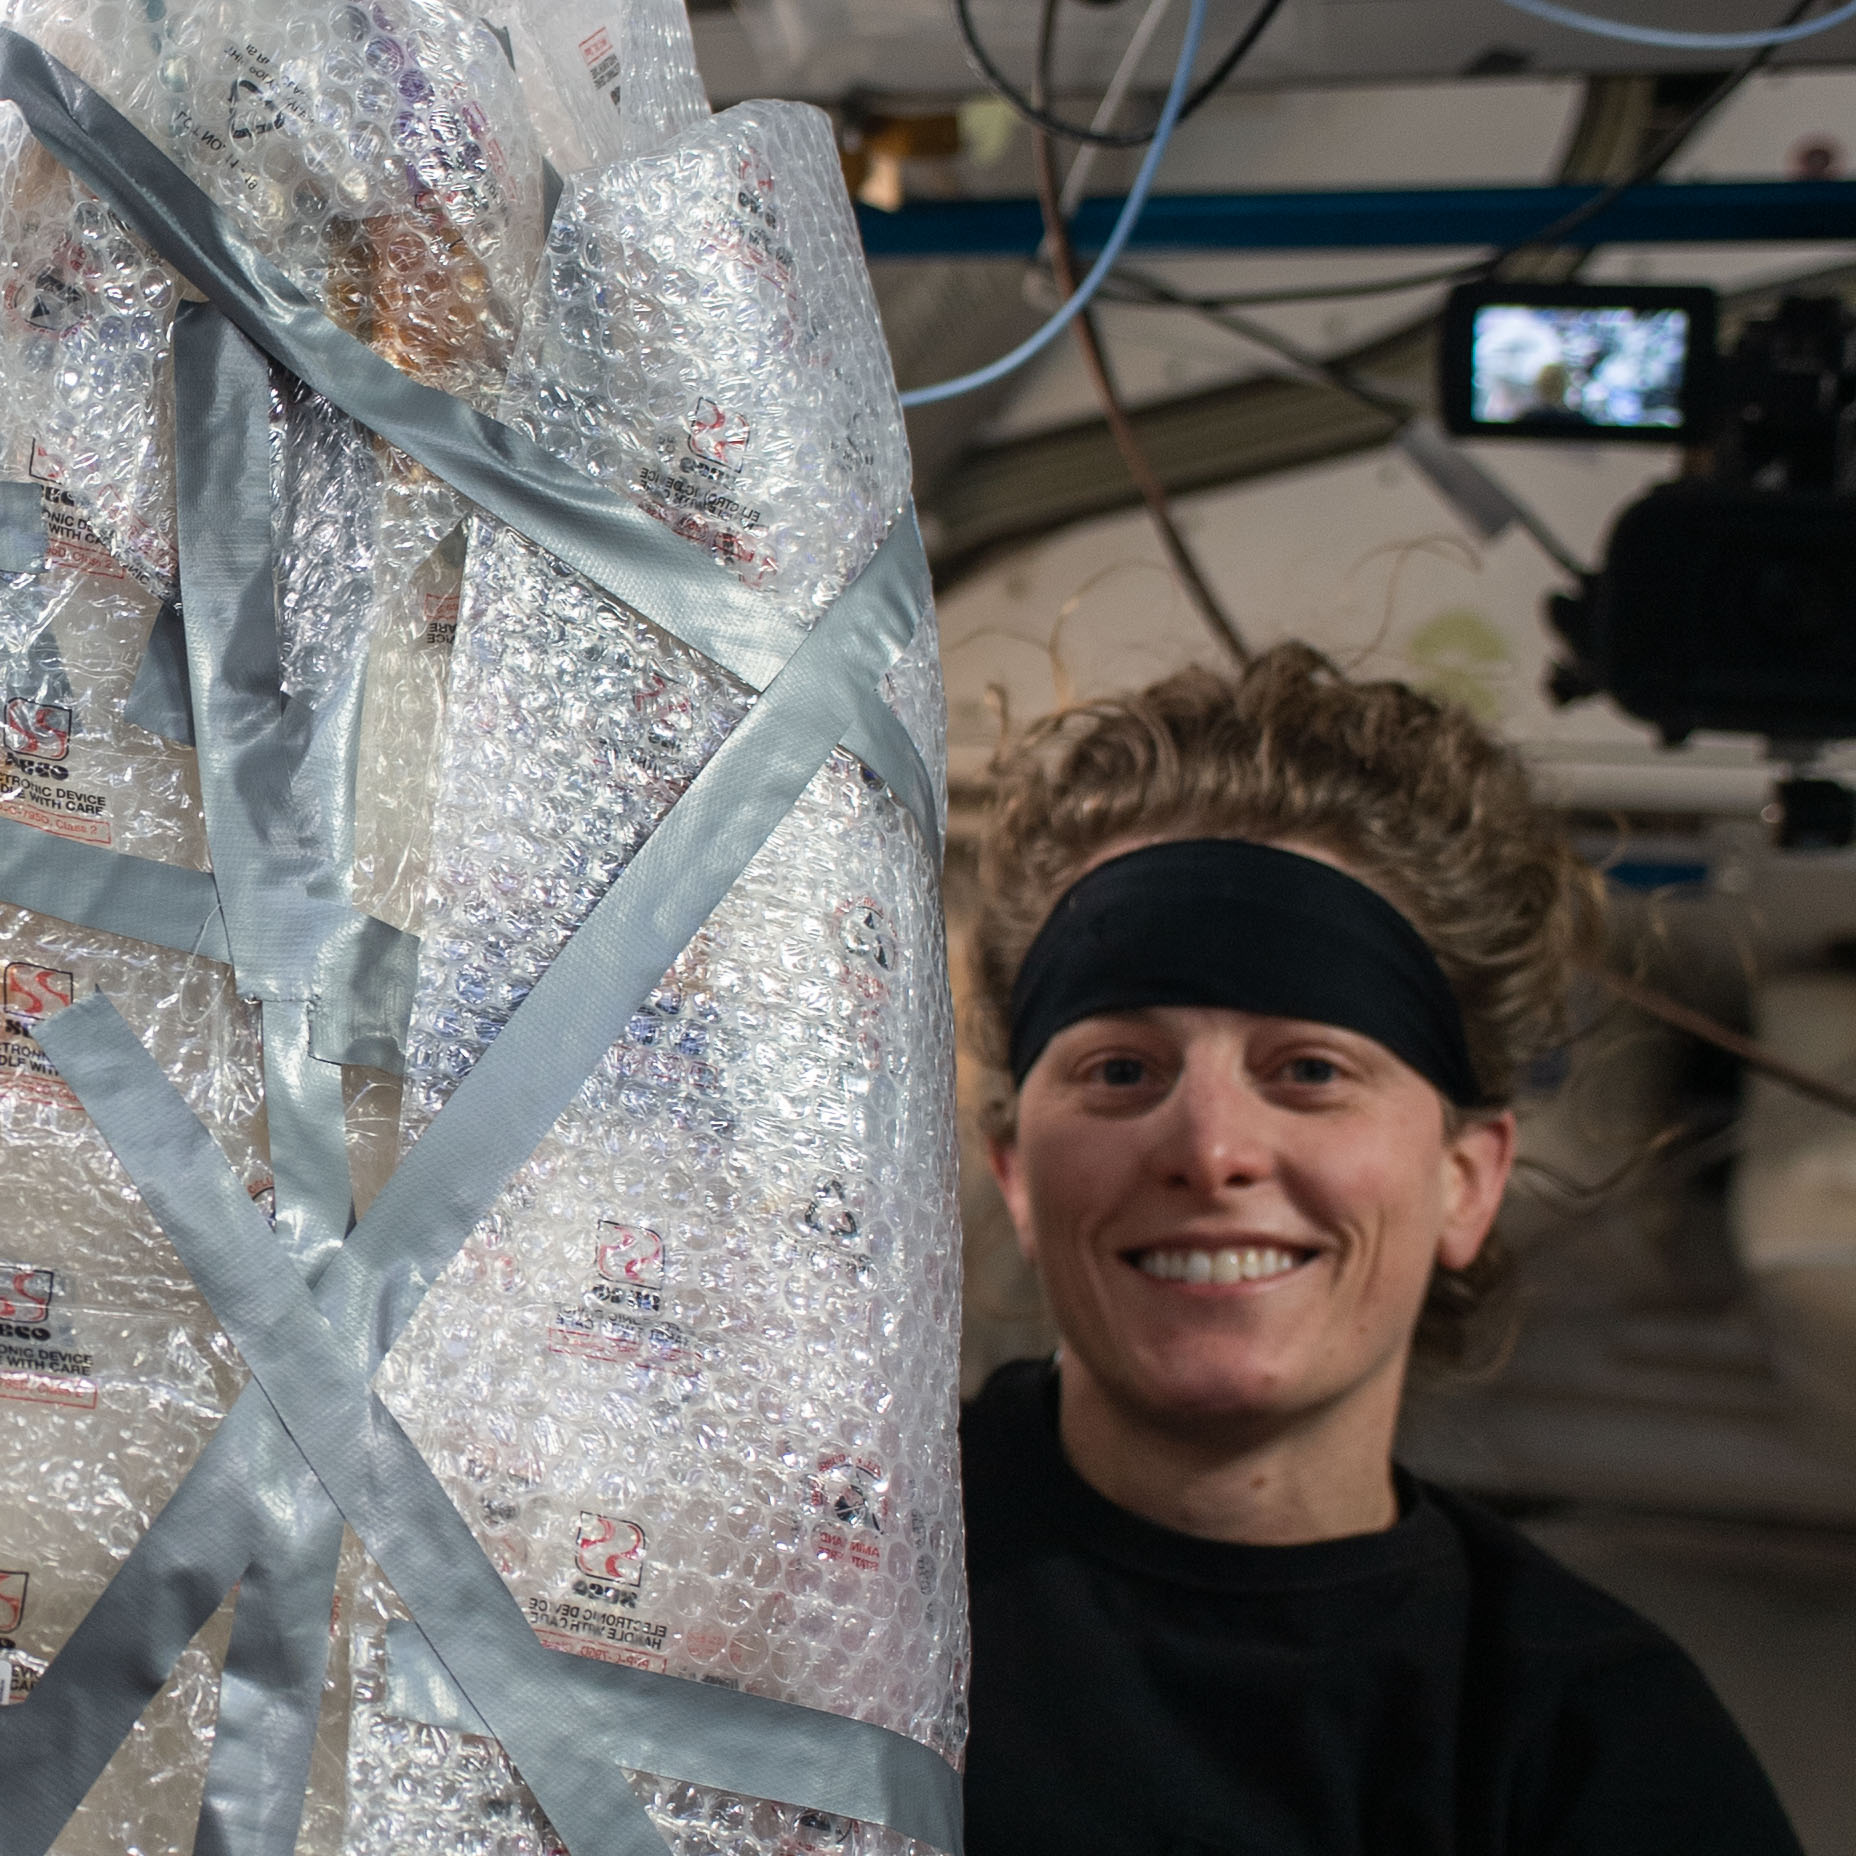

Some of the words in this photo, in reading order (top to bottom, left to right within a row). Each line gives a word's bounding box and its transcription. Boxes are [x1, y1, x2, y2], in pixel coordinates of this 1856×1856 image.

[427, 620, 457, 634] ARE
[27, 792, 63, 810] WITH
[64, 800, 104, 817] CARE
[55, 786, 107, 808] DEVICE
[6, 1356, 46, 1370] WITH
[48, 1361, 91, 1377] CARE
[36, 1348, 95, 1366] DEVICE
